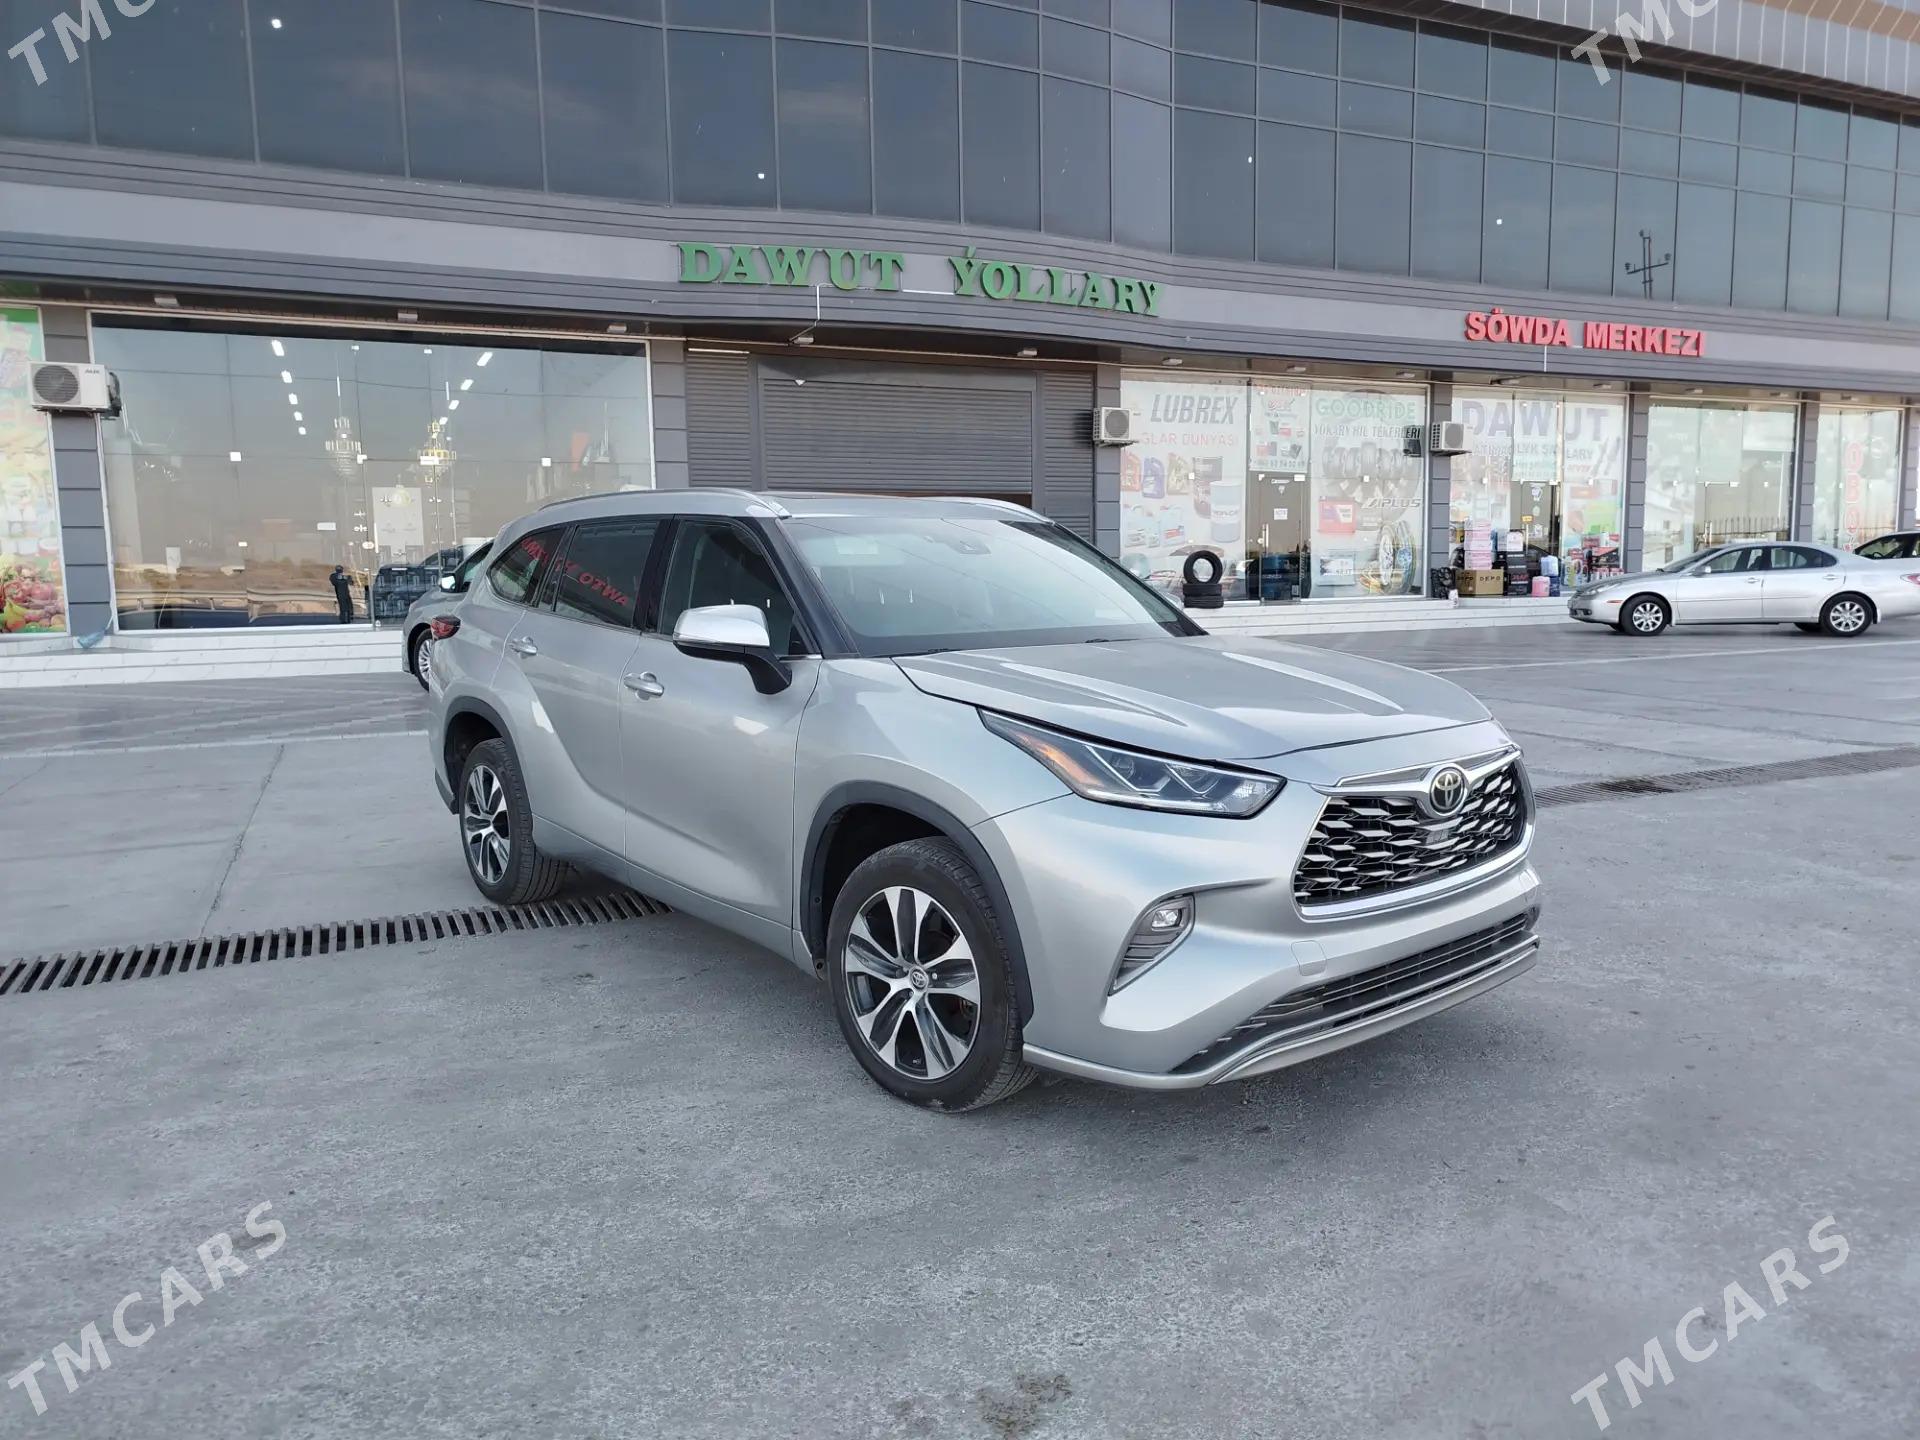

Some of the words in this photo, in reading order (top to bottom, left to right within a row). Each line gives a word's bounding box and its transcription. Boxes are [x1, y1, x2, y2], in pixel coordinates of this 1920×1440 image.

[677, 242, 904, 290] DAWUT
[949, 245, 1165, 317] ÝOLLARY
[1584, 321, 1706, 357] MERKEZI
[1150, 394, 1239, 425] LUBREX
[1315, 398, 1416, 421] GOODRIDE
[1462, 400, 1609, 441] DAWUT
[1361, 497, 1422, 509] APLUS
